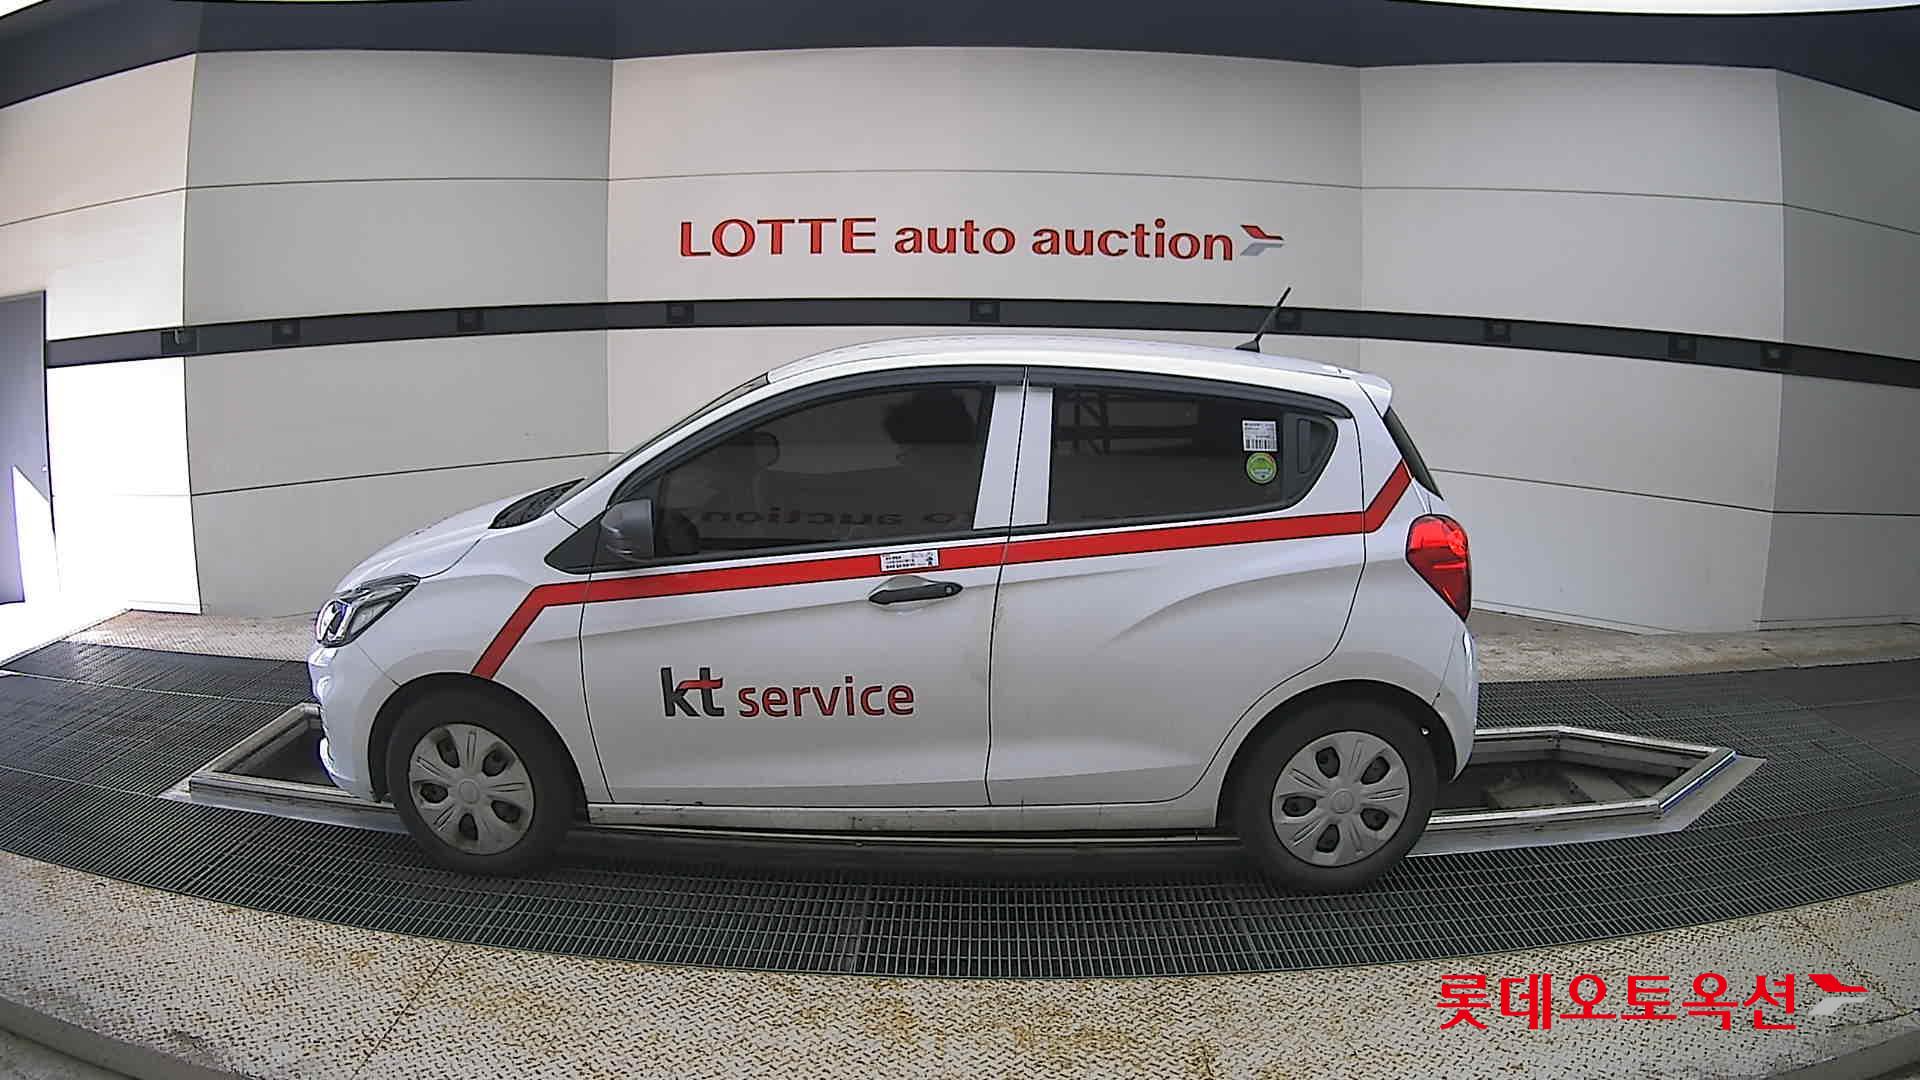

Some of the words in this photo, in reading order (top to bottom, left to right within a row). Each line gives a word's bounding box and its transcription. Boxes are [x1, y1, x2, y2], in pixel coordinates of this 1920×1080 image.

[680, 217, 878, 256] LOTTE
[894, 220, 1016, 254] auto
[1031, 218, 1233, 261] auction
[661, 667, 725, 717] kt
[739, 675, 915, 717] service
